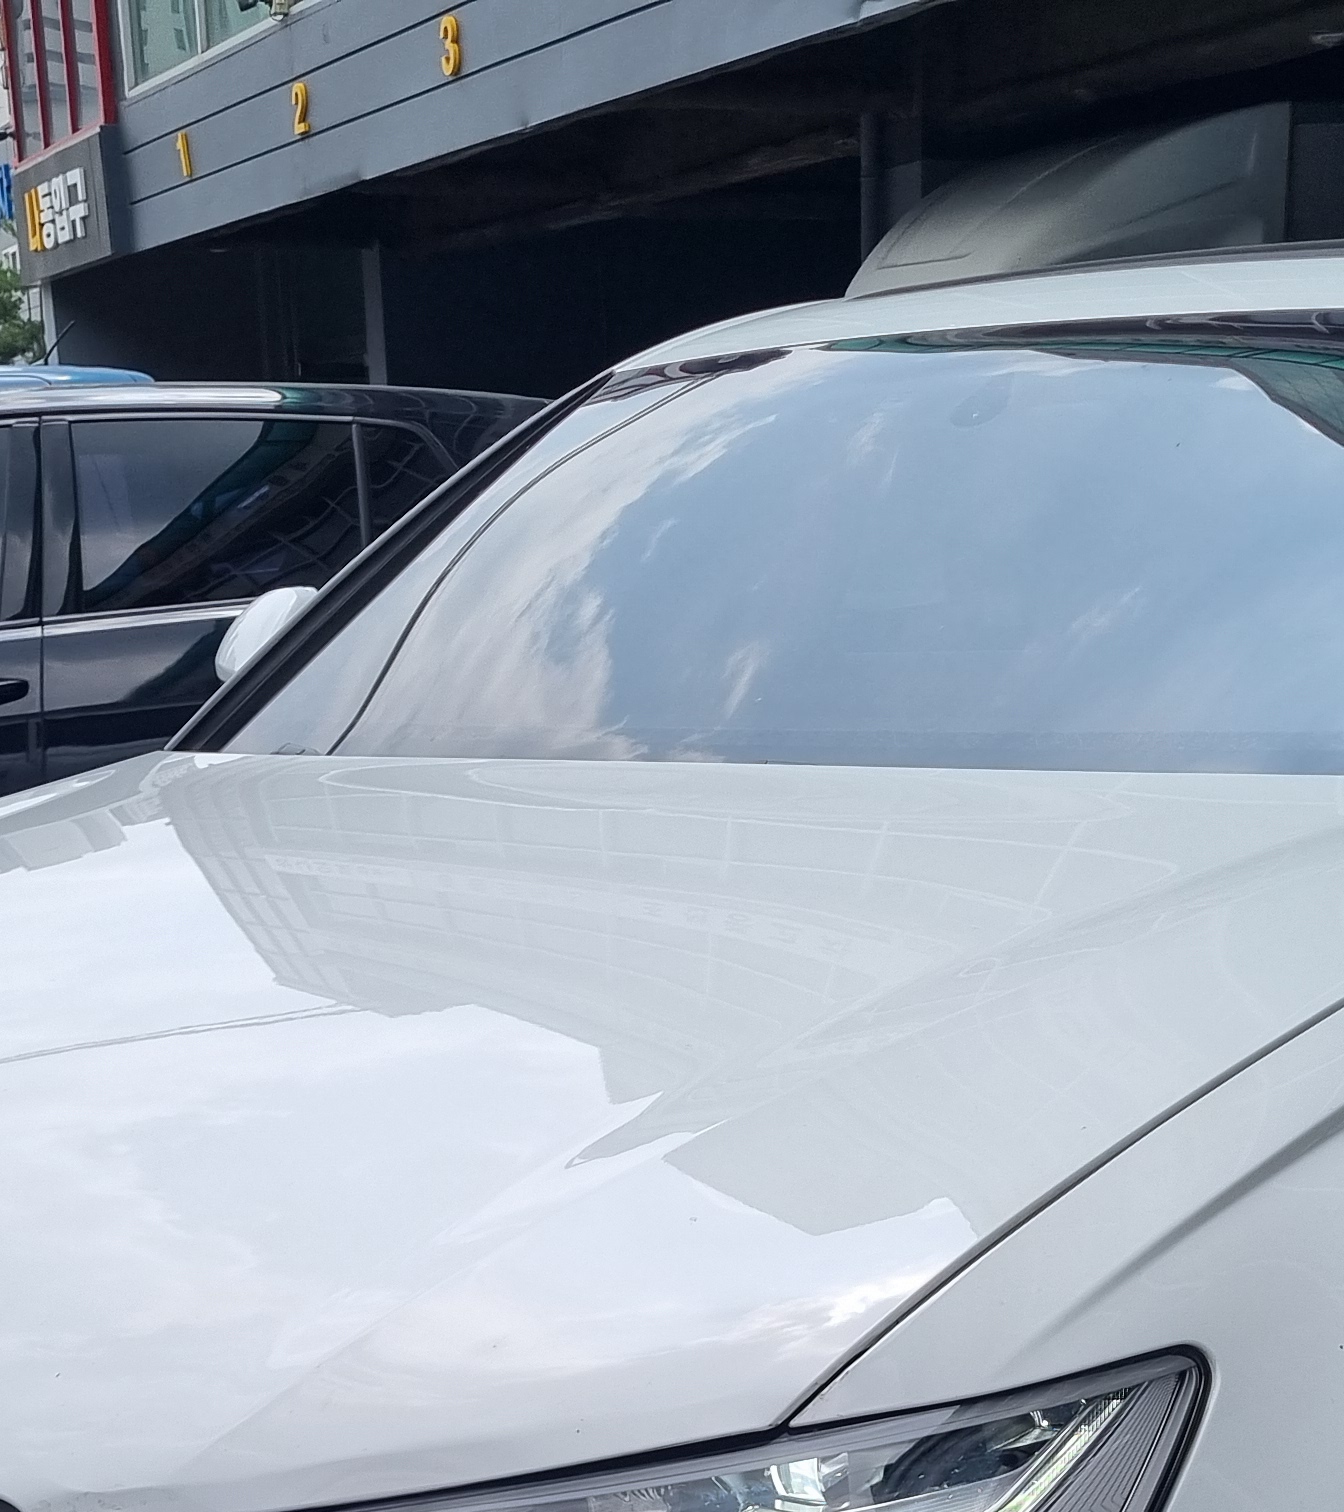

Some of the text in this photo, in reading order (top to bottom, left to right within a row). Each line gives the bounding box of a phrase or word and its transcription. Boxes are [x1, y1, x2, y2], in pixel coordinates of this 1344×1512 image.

[439, 15, 460, 76] 3
[291, 82, 310, 135] 2
[176, 131, 192, 177] 1
[24, 166, 89, 252] 나동입구
